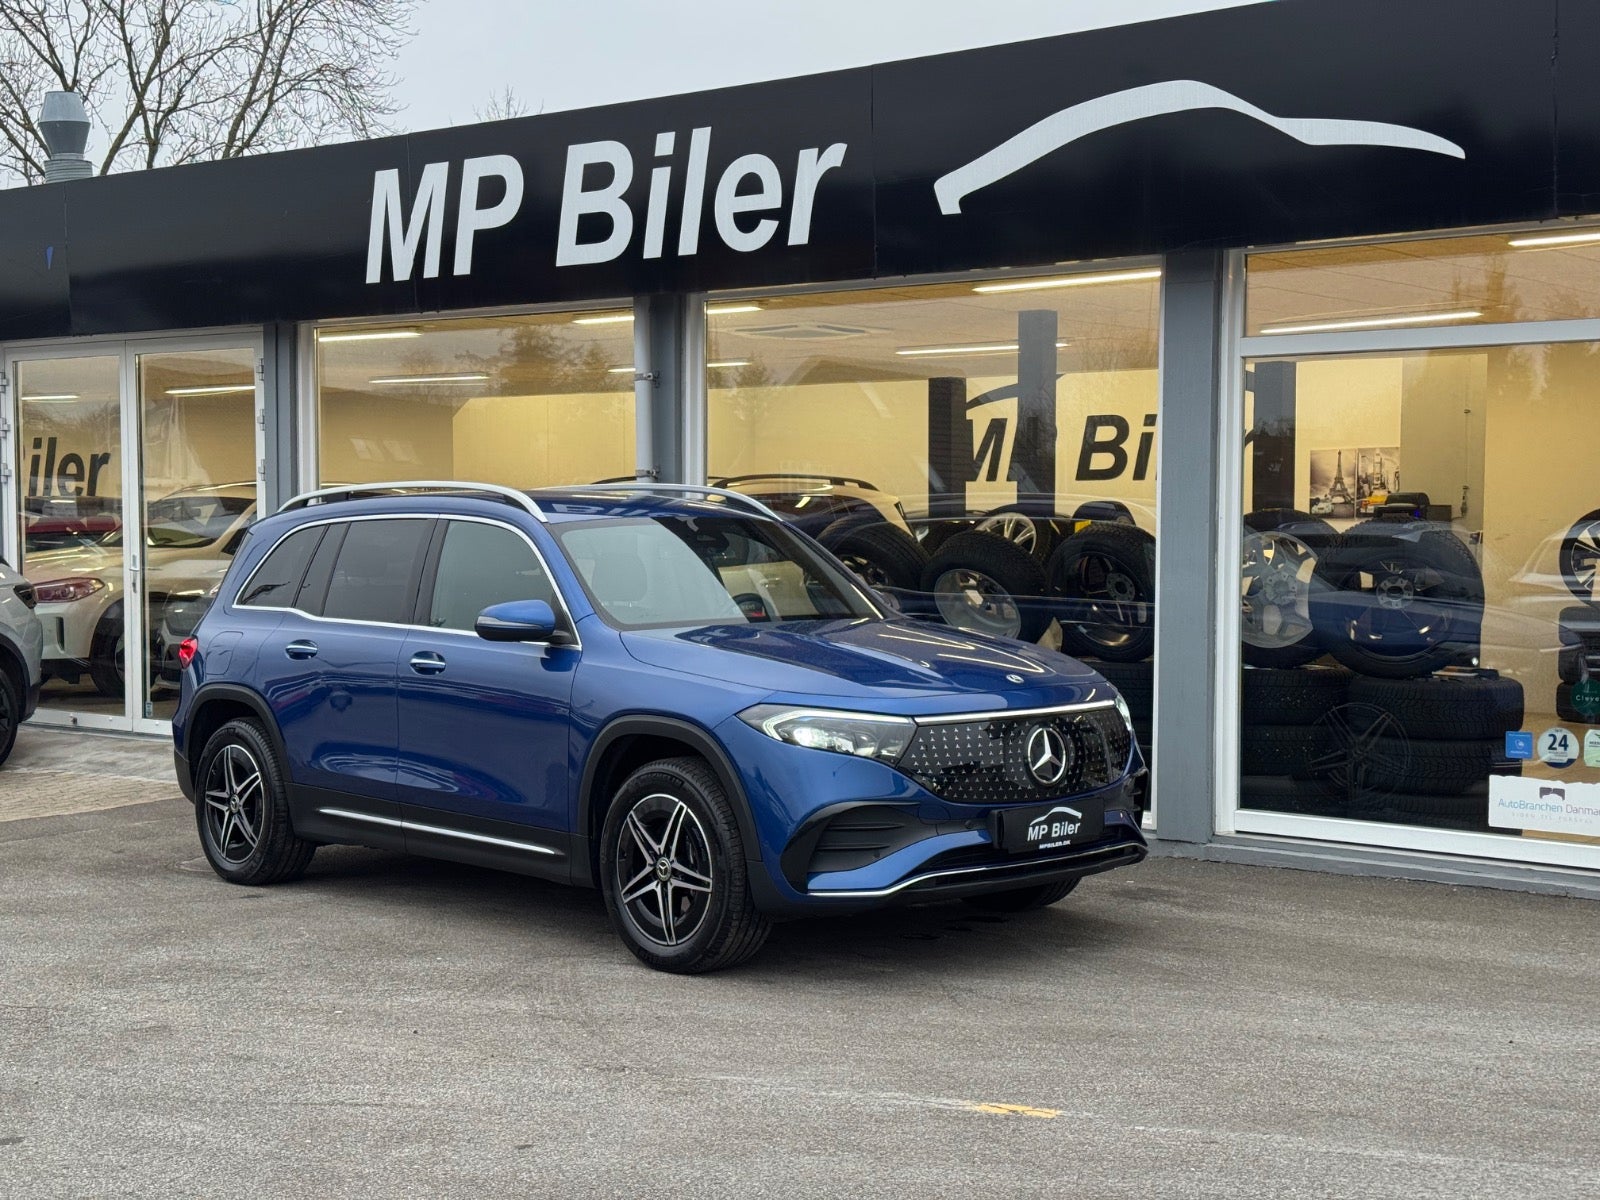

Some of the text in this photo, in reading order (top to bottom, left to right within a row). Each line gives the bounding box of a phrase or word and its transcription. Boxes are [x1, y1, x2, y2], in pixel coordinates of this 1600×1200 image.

[365, 126, 848, 284] MP Biler
[27, 436, 111, 497] iler
[1575, 694, 1600, 702] Cleve
[1547, 733, 1569, 751] 24
[1498, 798, 1600, 817] AutoBranchen Danma
[1027, 821, 1081, 841] MP Biler
